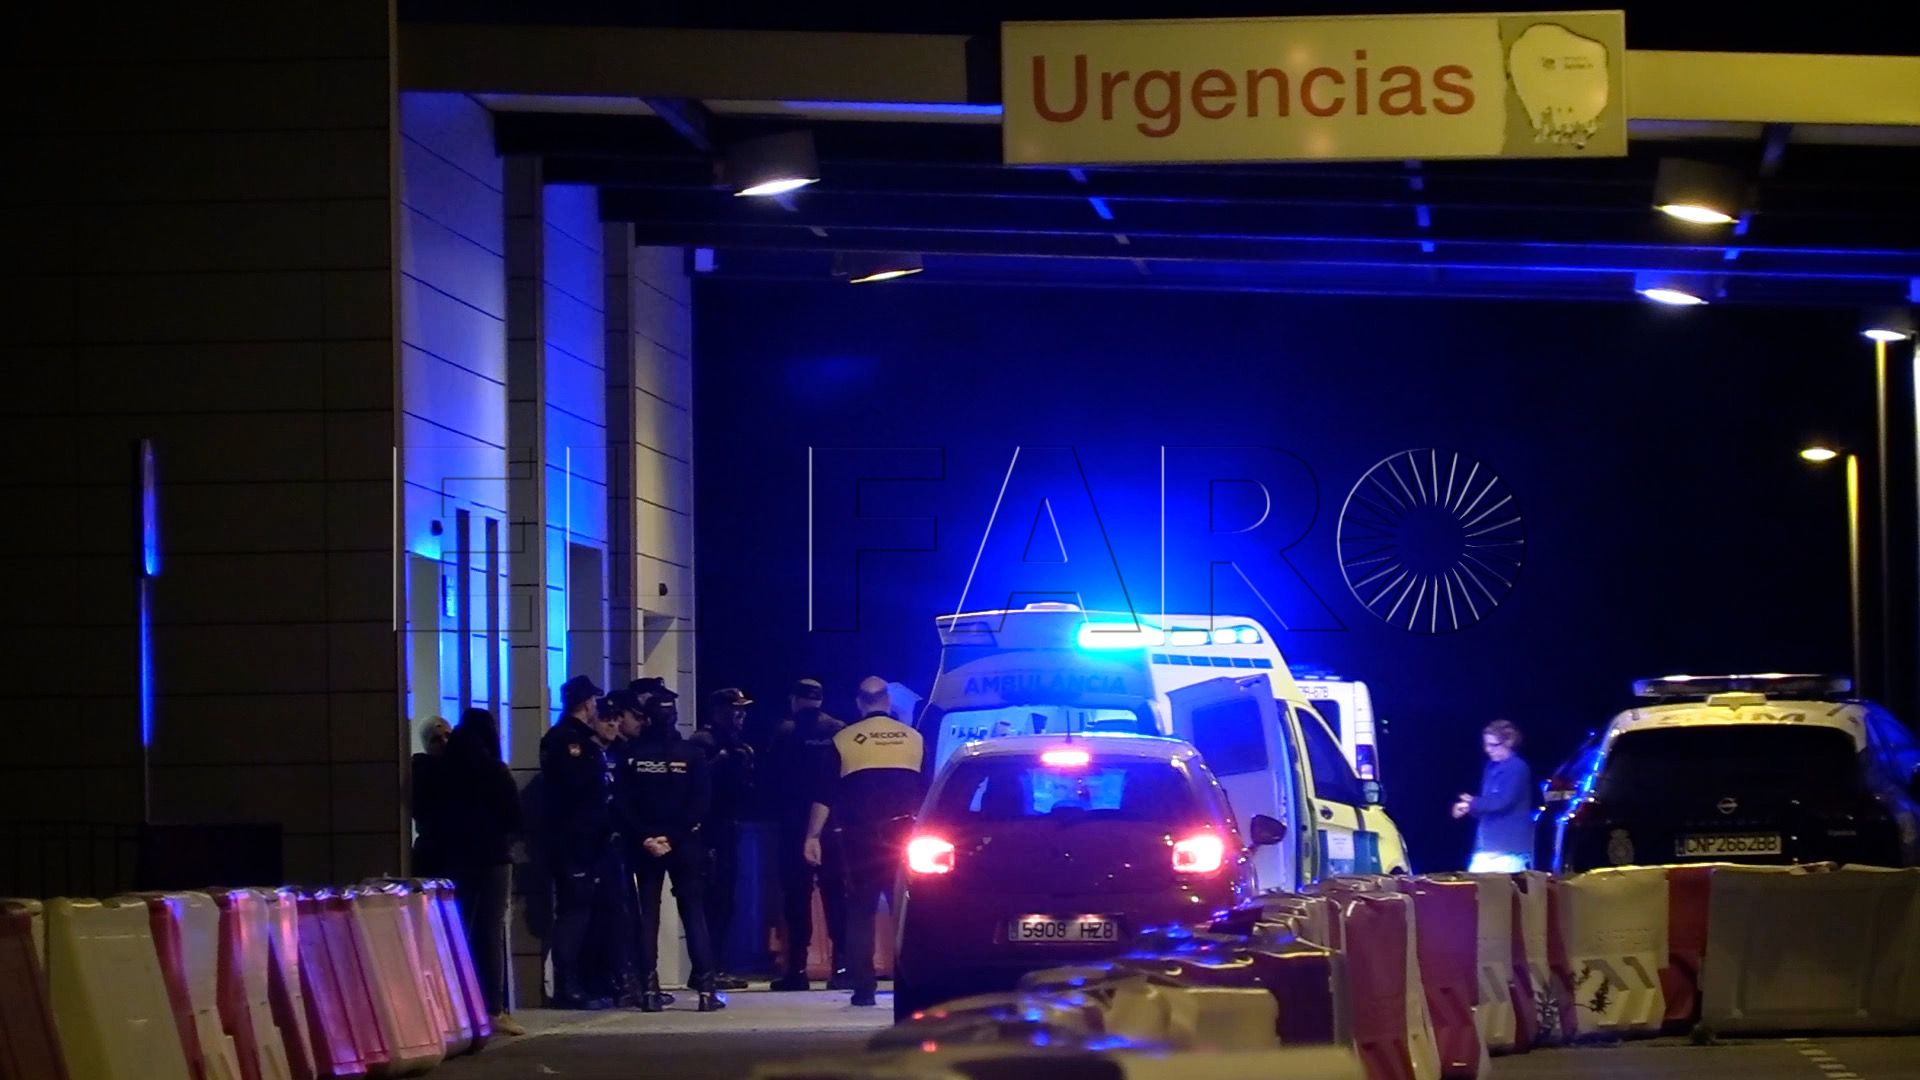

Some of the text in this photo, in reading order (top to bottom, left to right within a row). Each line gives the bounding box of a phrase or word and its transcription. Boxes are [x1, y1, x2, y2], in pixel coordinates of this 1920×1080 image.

[1032, 50, 1475, 138] Urgencias
[964, 673, 1128, 696] AMBULANCIA
[1022, 921, 1066, 939] 5908
